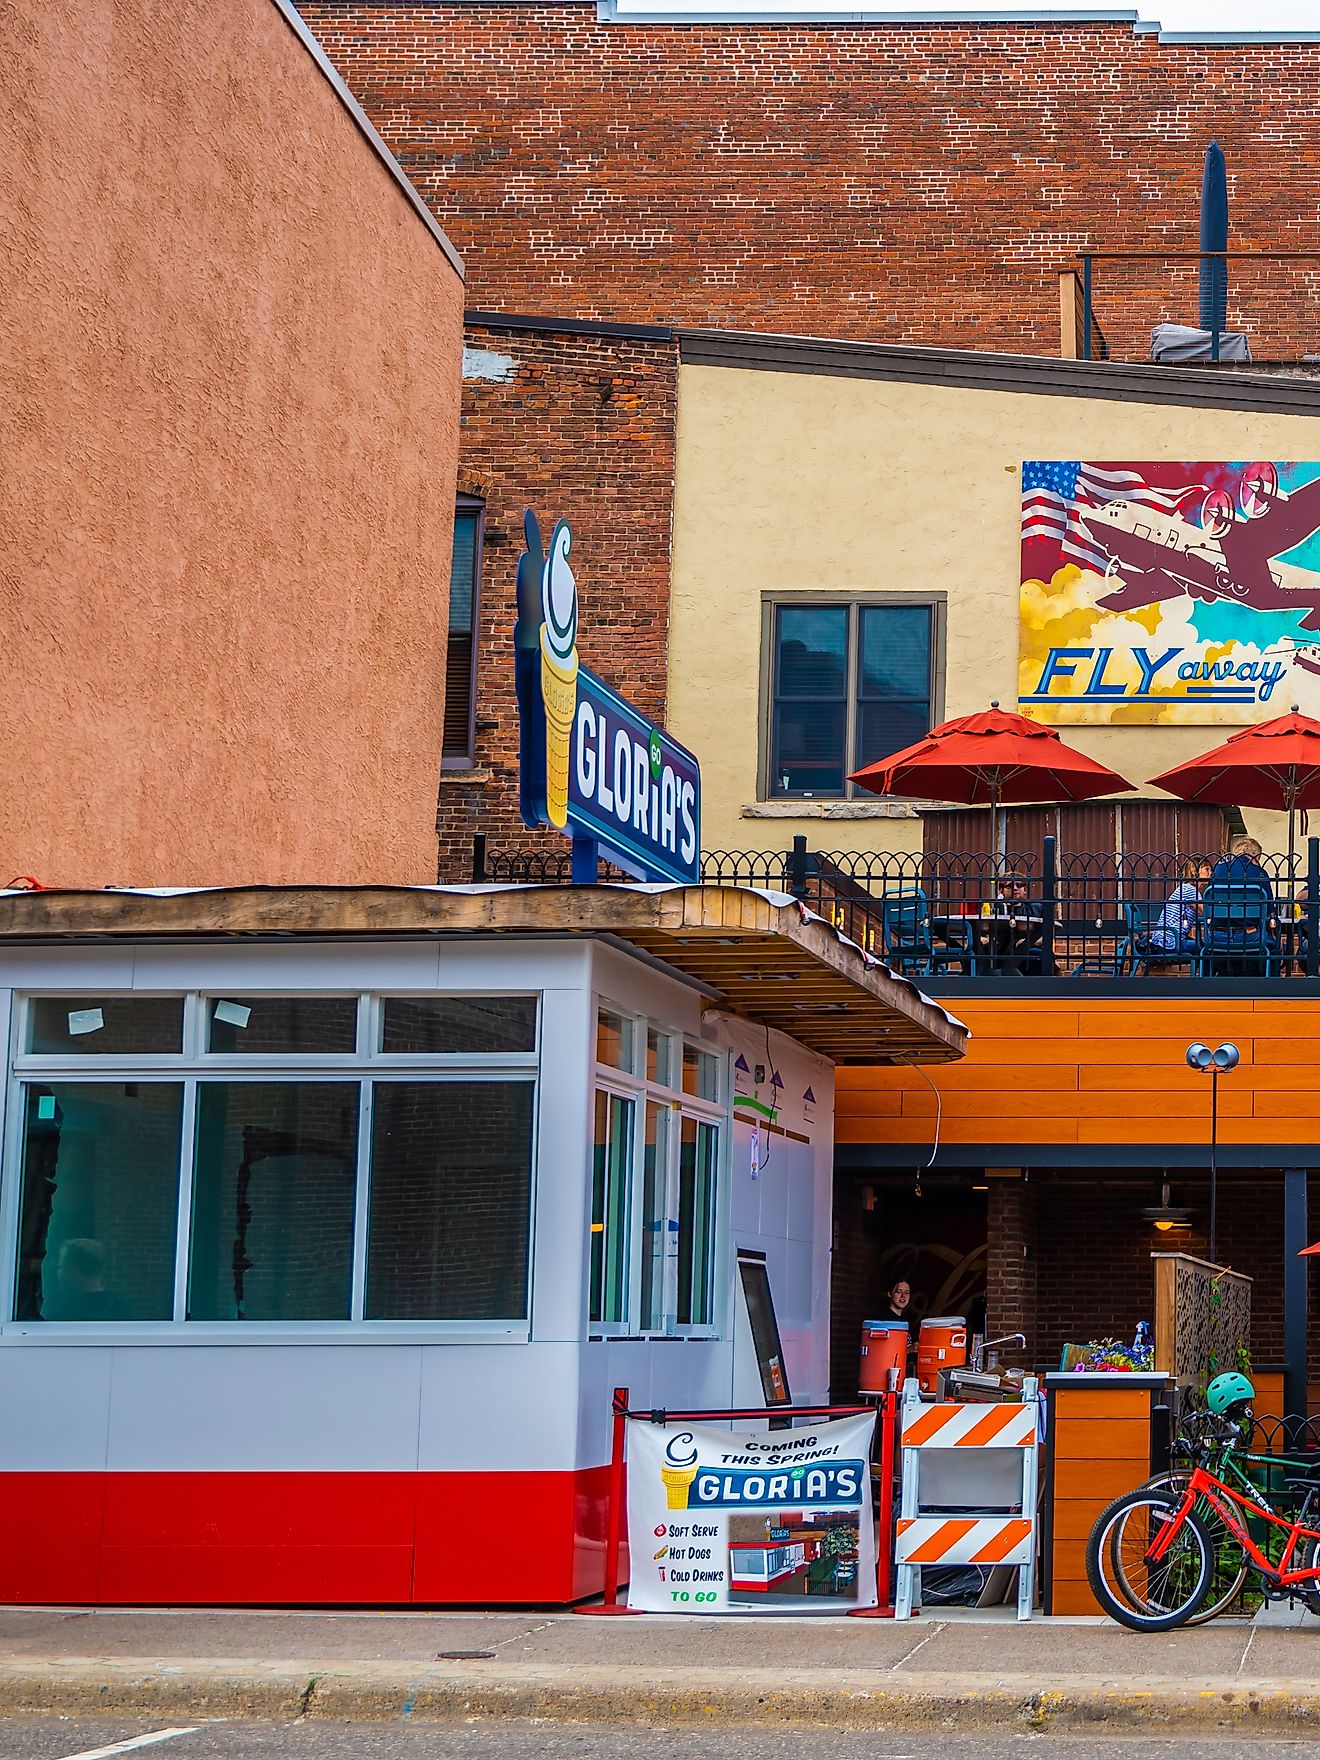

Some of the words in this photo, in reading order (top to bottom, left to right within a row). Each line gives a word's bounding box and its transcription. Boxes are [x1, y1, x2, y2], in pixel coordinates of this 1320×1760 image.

[1032, 647, 1185, 695] FLY
[1177, 660, 1287, 702] away
[651, 743, 662, 766] GO
[745, 1436, 818, 1452] COMING
[720, 1454, 761, 1465] THIS
[766, 1445, 840, 1465] SPRING!
[1245, 1480, 1274, 1514] TREK
[669, 1524, 689, 1537] SOFT
[692, 1524, 719, 1537] SERVE
[669, 1547, 686, 1560] HOT
[688, 1547, 711, 1560] DOGS
[671, 1569, 690, 1582] COLD
[692, 1569, 724, 1582] DRINKS
[671, 1591, 690, 1602] TO
[695, 1591, 717, 1602] GO
